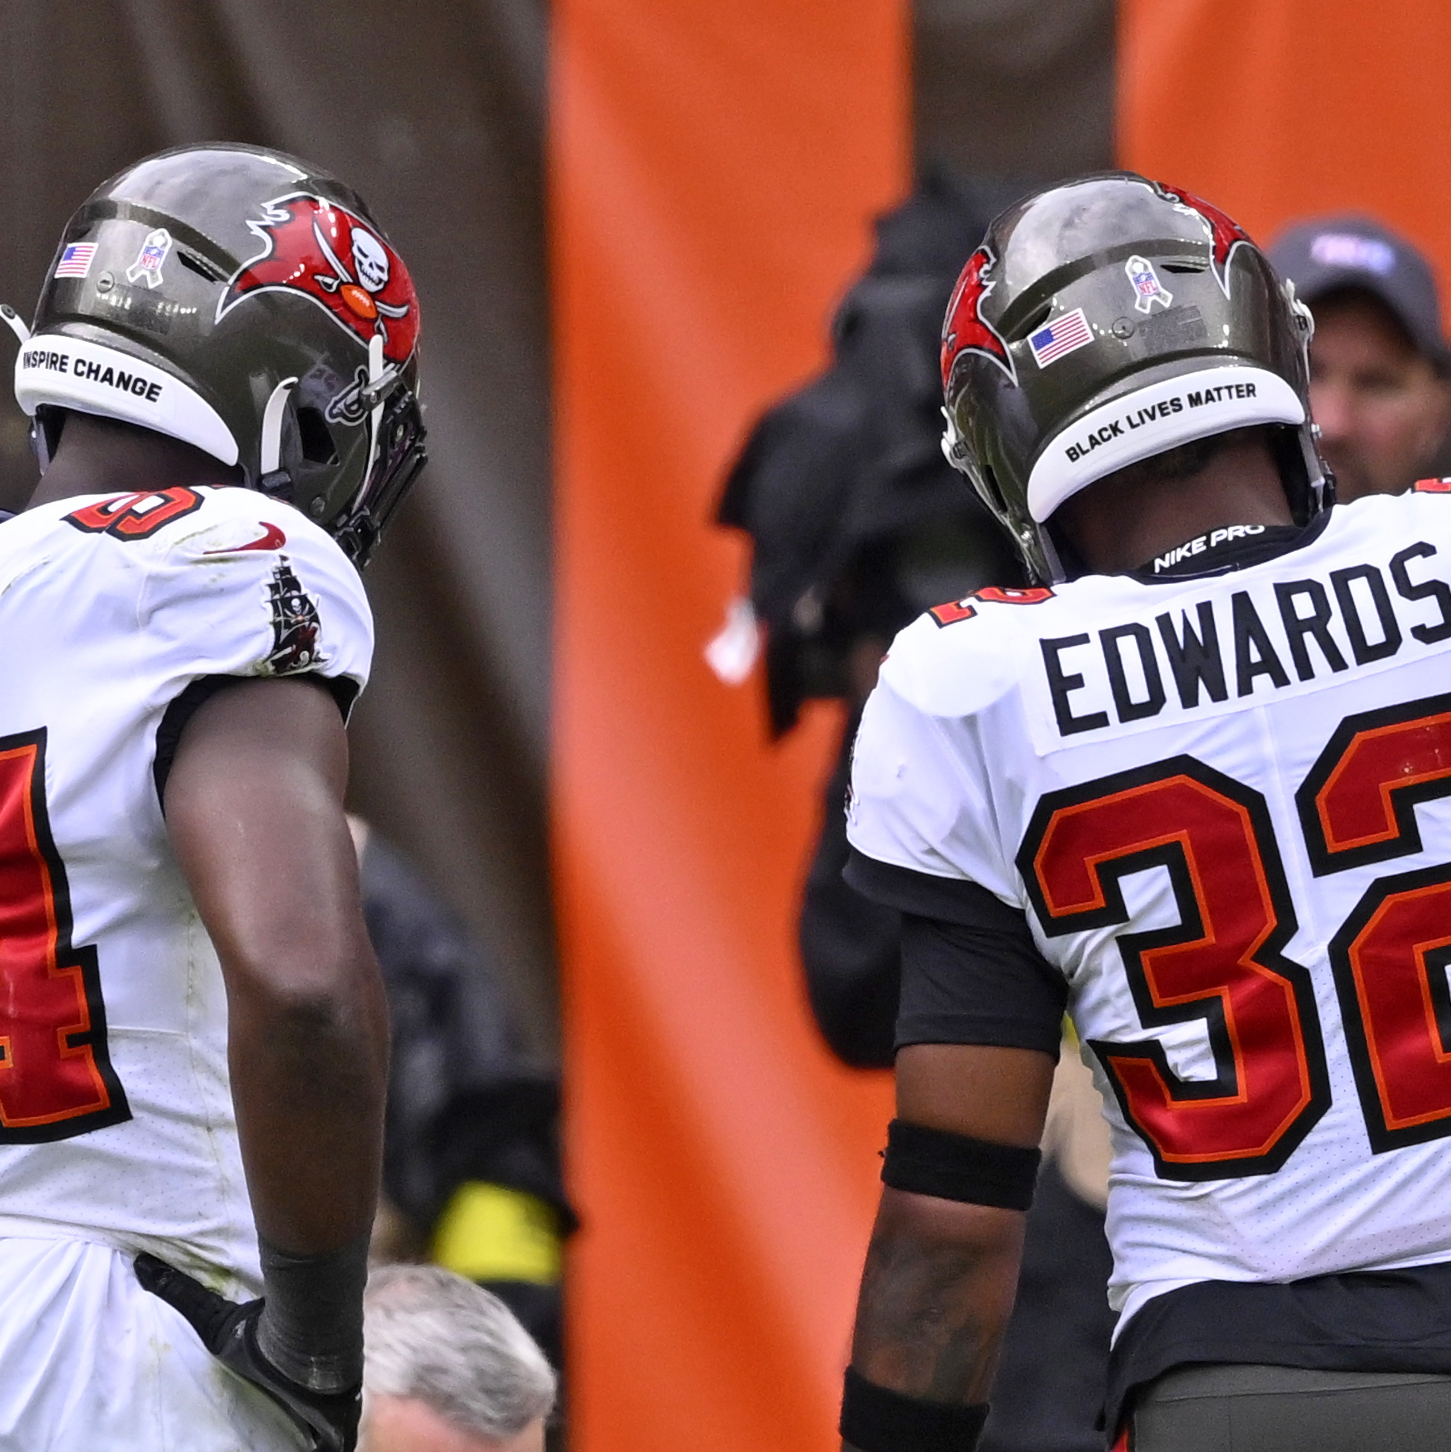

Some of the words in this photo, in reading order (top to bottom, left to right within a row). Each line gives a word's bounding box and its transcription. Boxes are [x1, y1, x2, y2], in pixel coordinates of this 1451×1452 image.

[23, 350, 70, 374] INSPIRE
[73, 358, 163, 403] CHANGE
[1064, 420, 1125, 463] BLACK
[1125, 397, 1184, 430] LIVES
[1186, 383, 1258, 409] MATTER
[1153, 535, 1208, 574] NIKE
[1210, 524, 1266, 548] PRO
